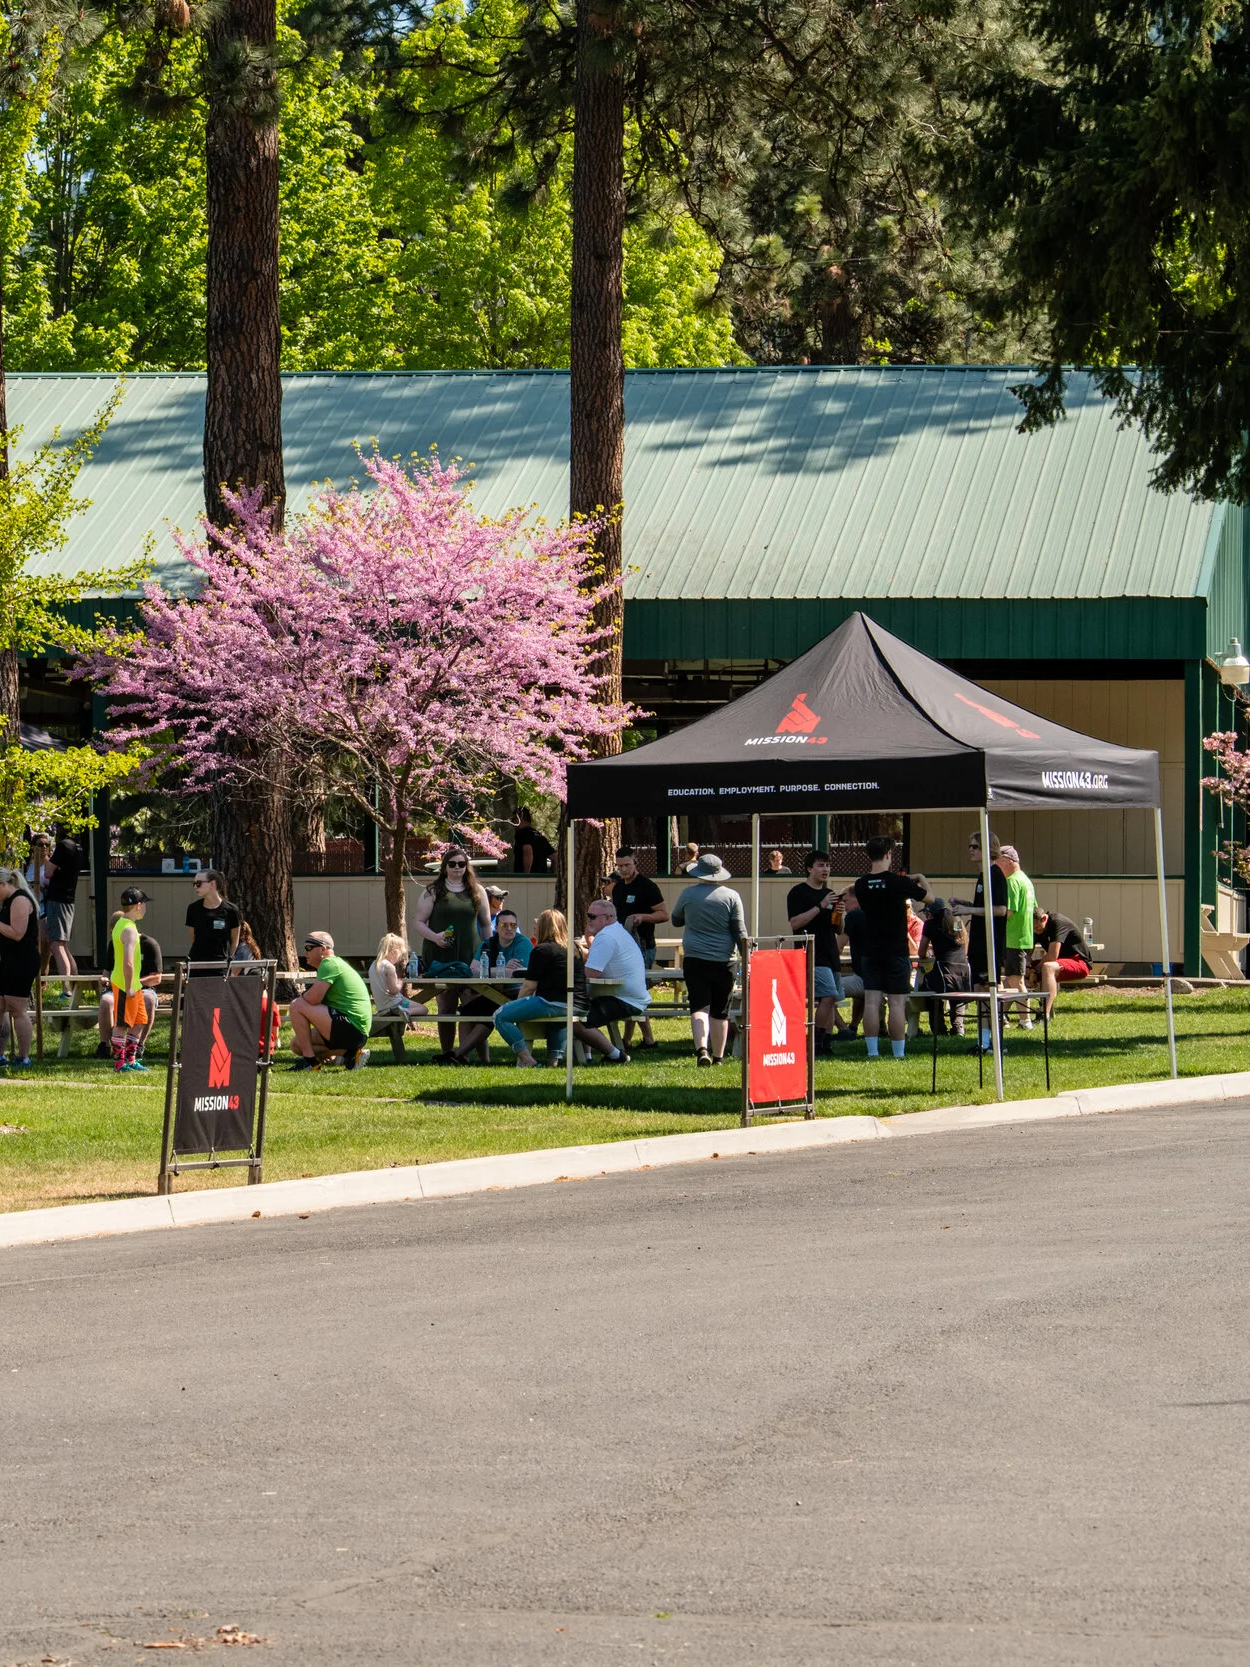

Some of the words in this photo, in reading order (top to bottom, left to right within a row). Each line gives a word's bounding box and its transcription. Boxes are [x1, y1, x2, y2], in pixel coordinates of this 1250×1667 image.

[744, 735, 828, 746] MISSION43
[1041, 771, 1109, 790] MISSION43.ORG
[667, 788, 715, 797] EDUCATION.
[718, 785, 776, 795] EMPLOYMENT.
[779, 784, 821, 793] PURPOSE.
[824, 782, 880, 791] CONNECTION.
[762, 1052, 796, 1067] MISSION43
[193, 1095, 240, 1112] MISSION43
